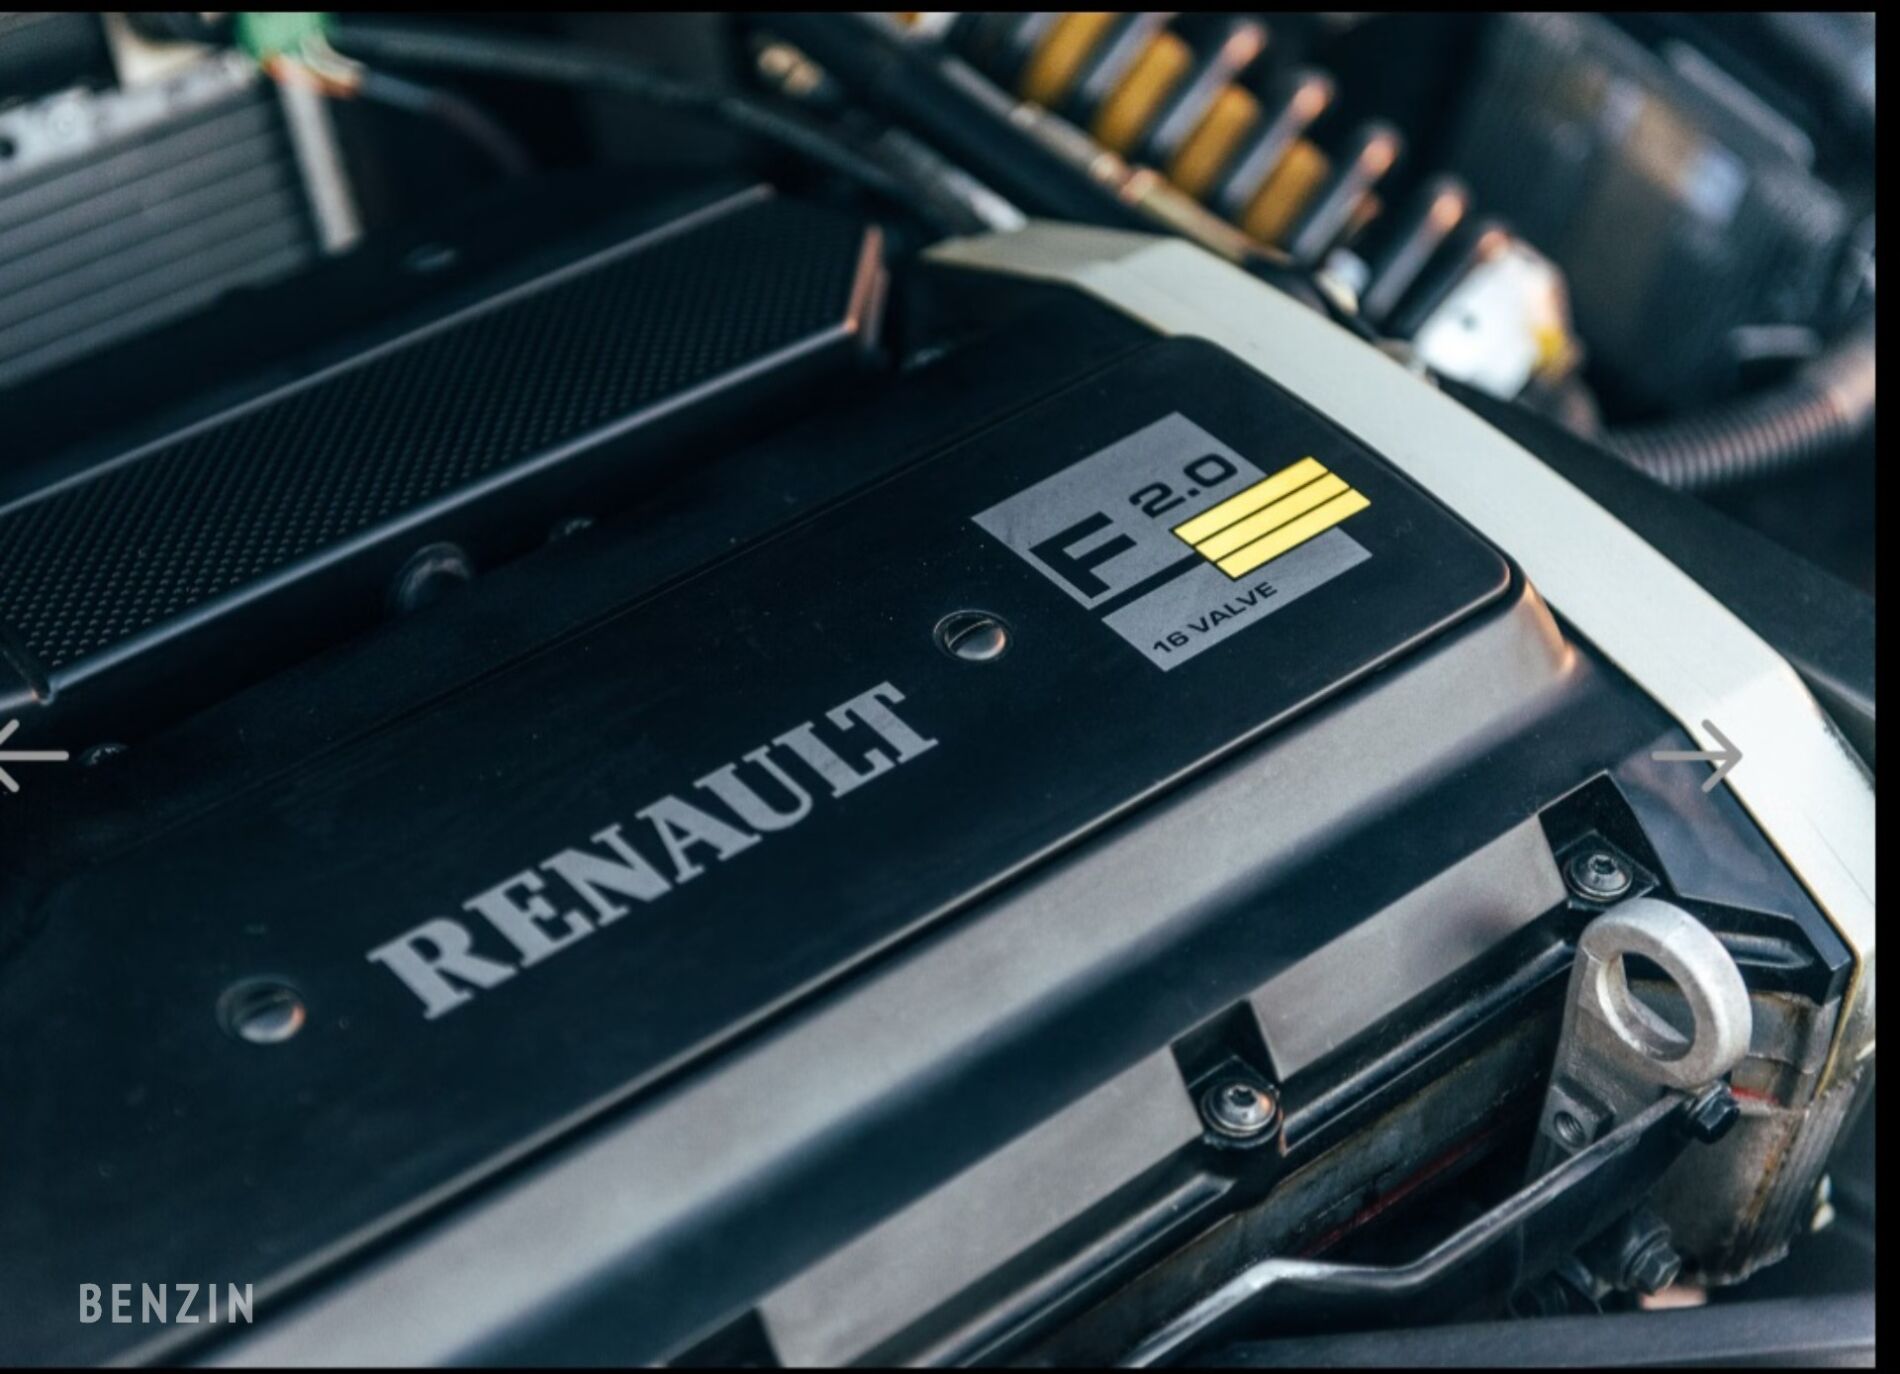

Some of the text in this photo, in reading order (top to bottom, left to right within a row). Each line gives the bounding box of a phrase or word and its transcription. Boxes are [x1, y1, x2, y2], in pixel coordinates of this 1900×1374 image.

[1028, 453, 1239, 600] F 2.0
[1152, 581, 1279, 654] 16 VALVE
[366, 680, 940, 1021] RENAULT
